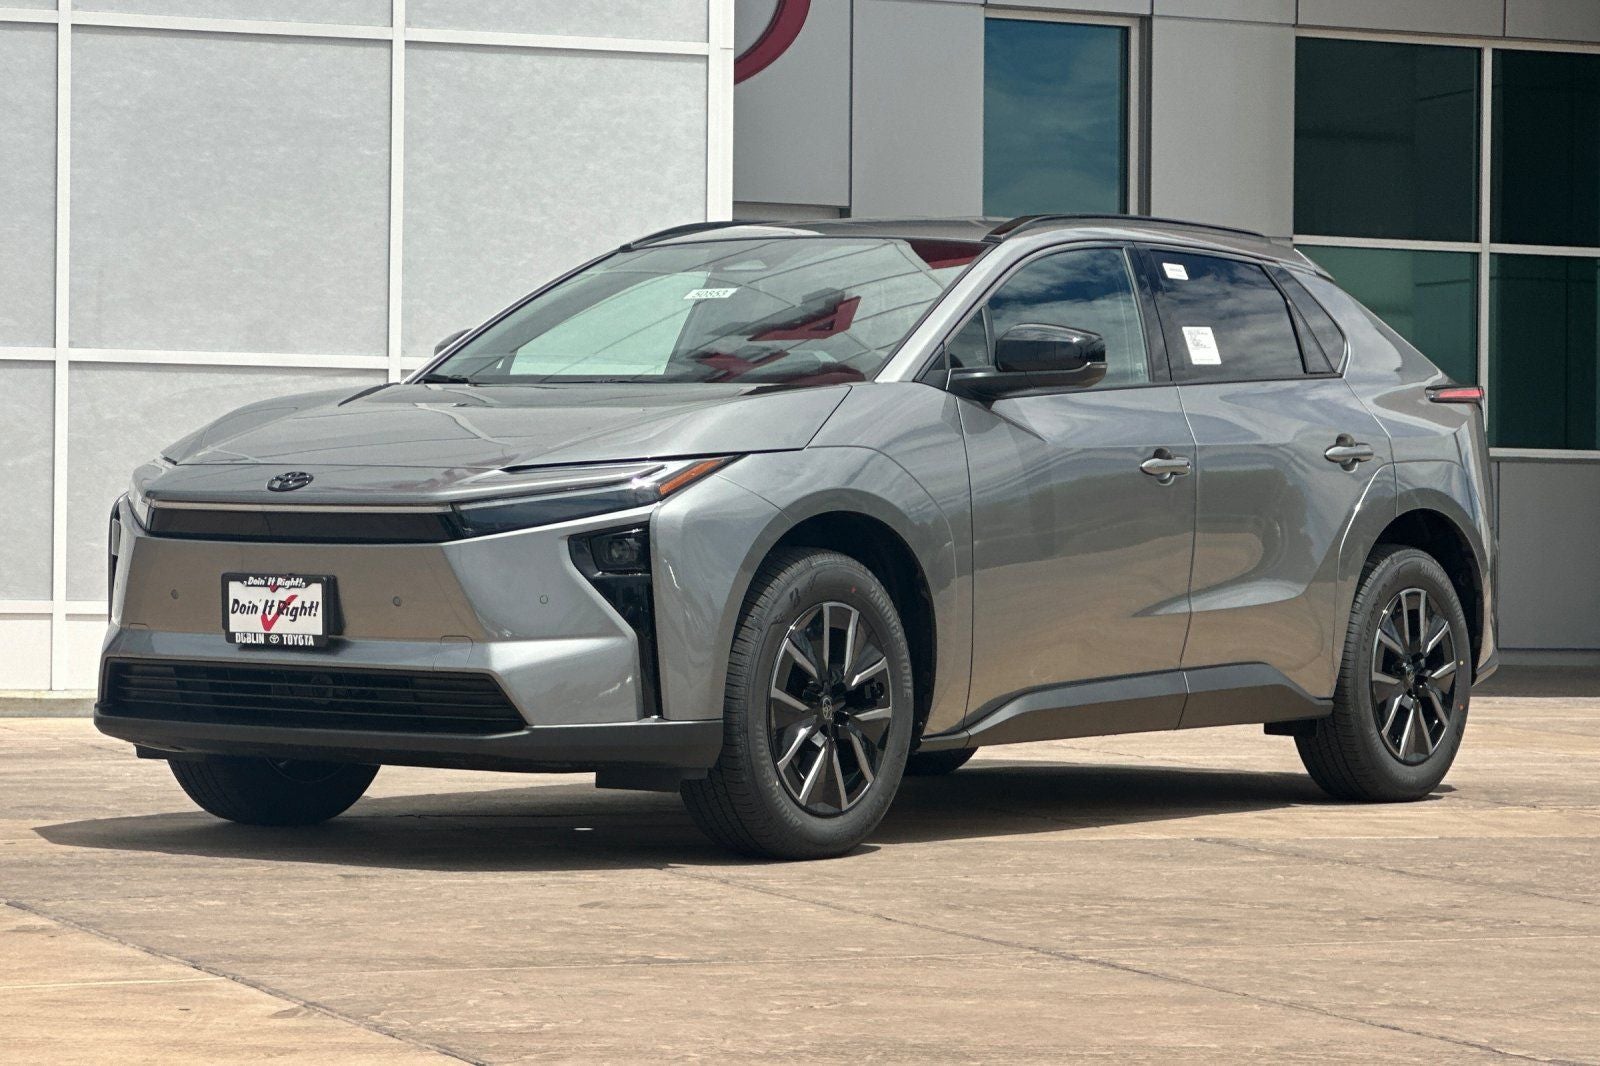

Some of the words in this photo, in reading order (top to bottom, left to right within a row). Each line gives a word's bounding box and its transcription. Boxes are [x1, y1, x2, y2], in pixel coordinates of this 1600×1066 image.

[247, 576, 266, 586] Doin'
[268, 577, 275, 586] It
[277, 577, 303, 588] Right!
[231, 598, 262, 615] Doin'
[263, 600, 274, 615] It
[277, 601, 319, 622] Right!
[235, 632, 264, 644] DUBLIN
[282, 634, 314, 646] TOYOTA
